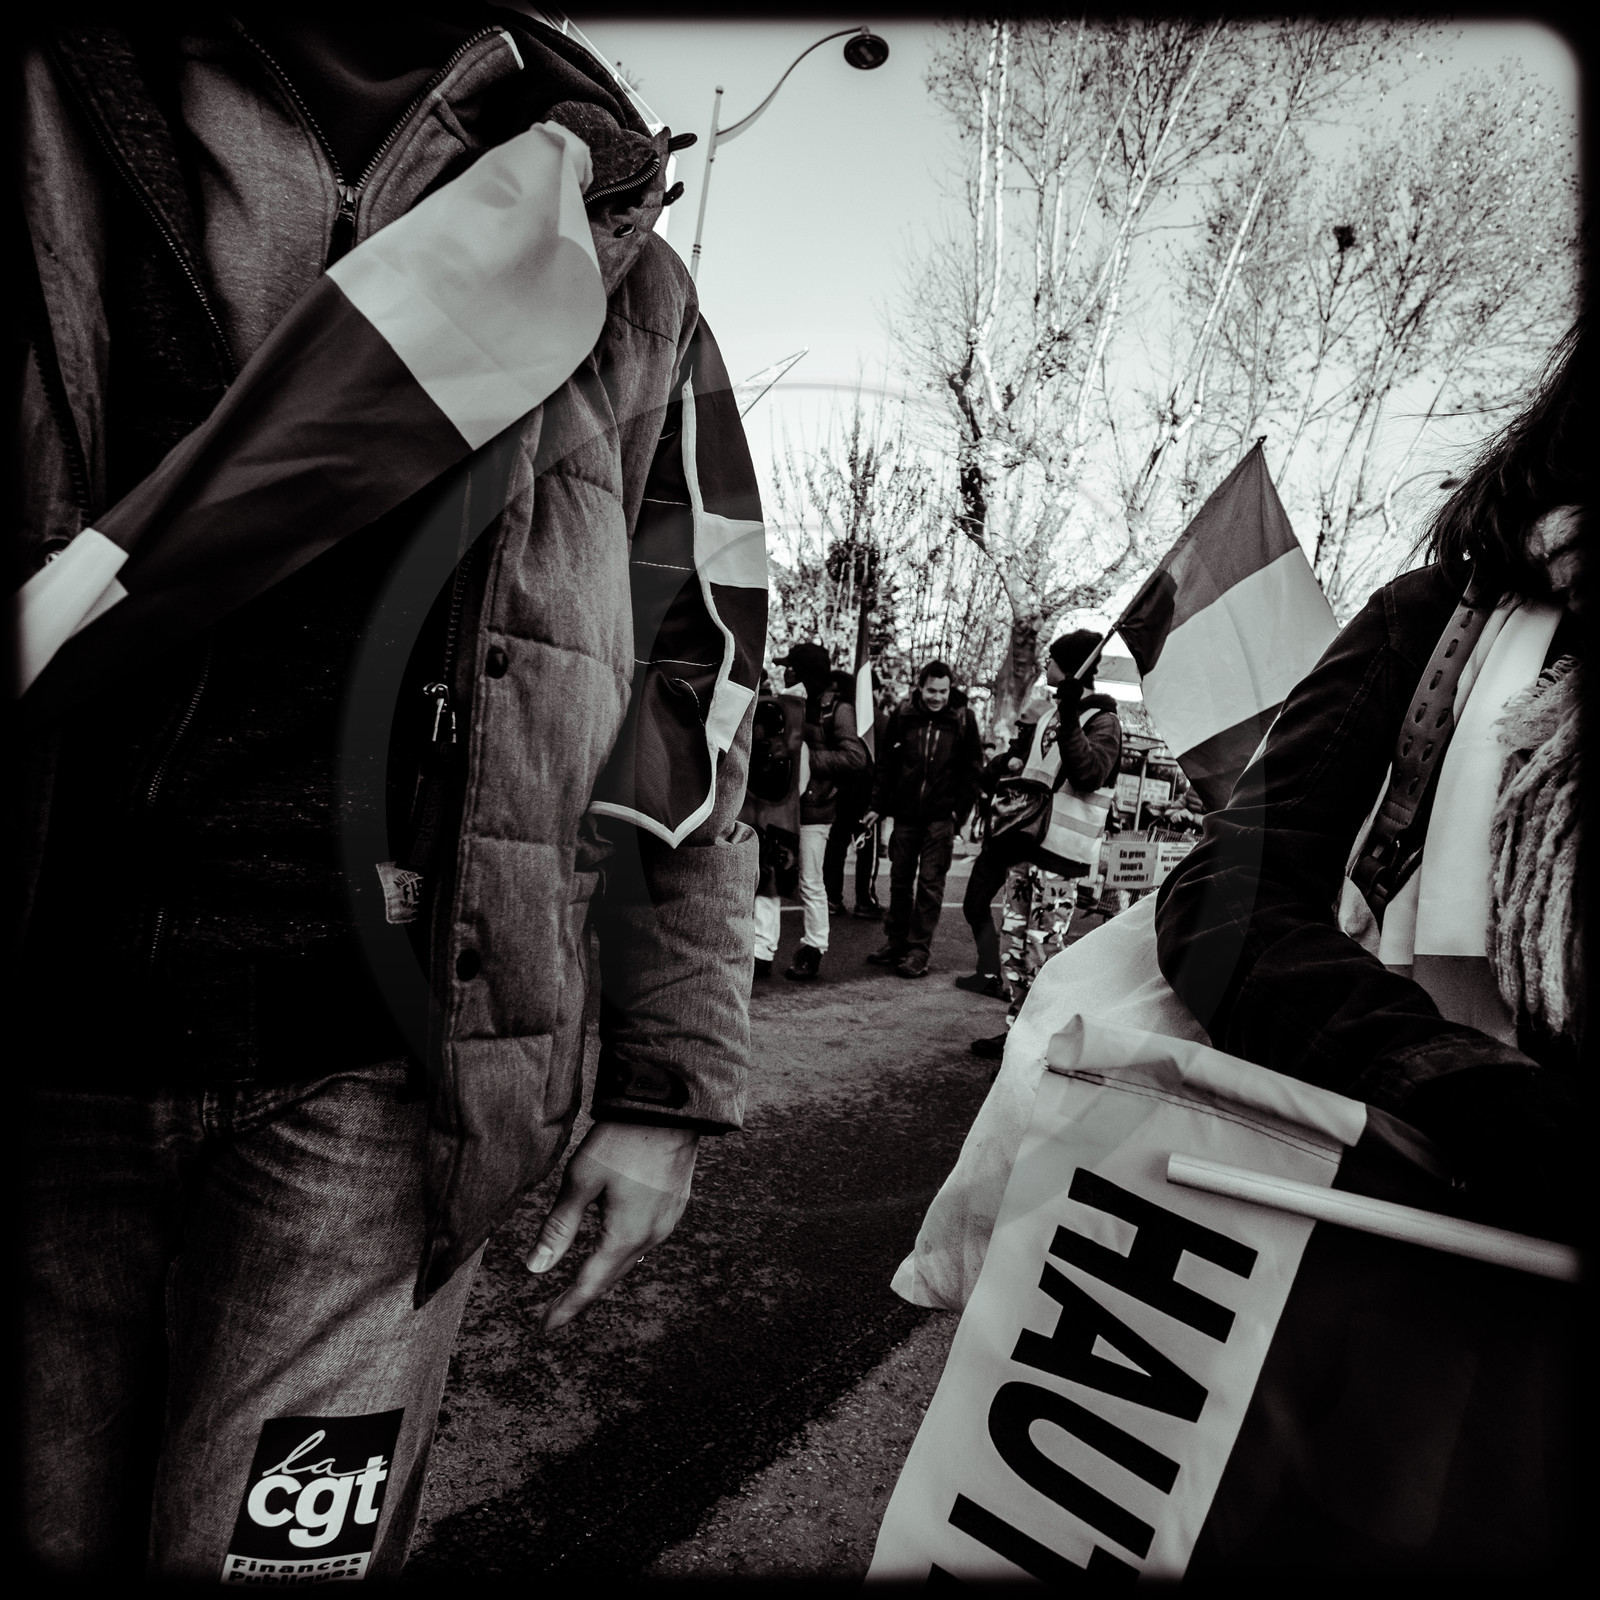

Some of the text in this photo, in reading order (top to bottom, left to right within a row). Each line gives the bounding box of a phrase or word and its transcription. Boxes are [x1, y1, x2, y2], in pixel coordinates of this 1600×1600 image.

[1119, 849, 1128, 858] En
[1120, 873, 1145, 882] retraite
[262, 1429, 388, 1477] la
[247, 1455, 388, 1548] cgt
[232, 1555, 362, 1574] Finances
[228, 1566, 359, 1587] Publiques
